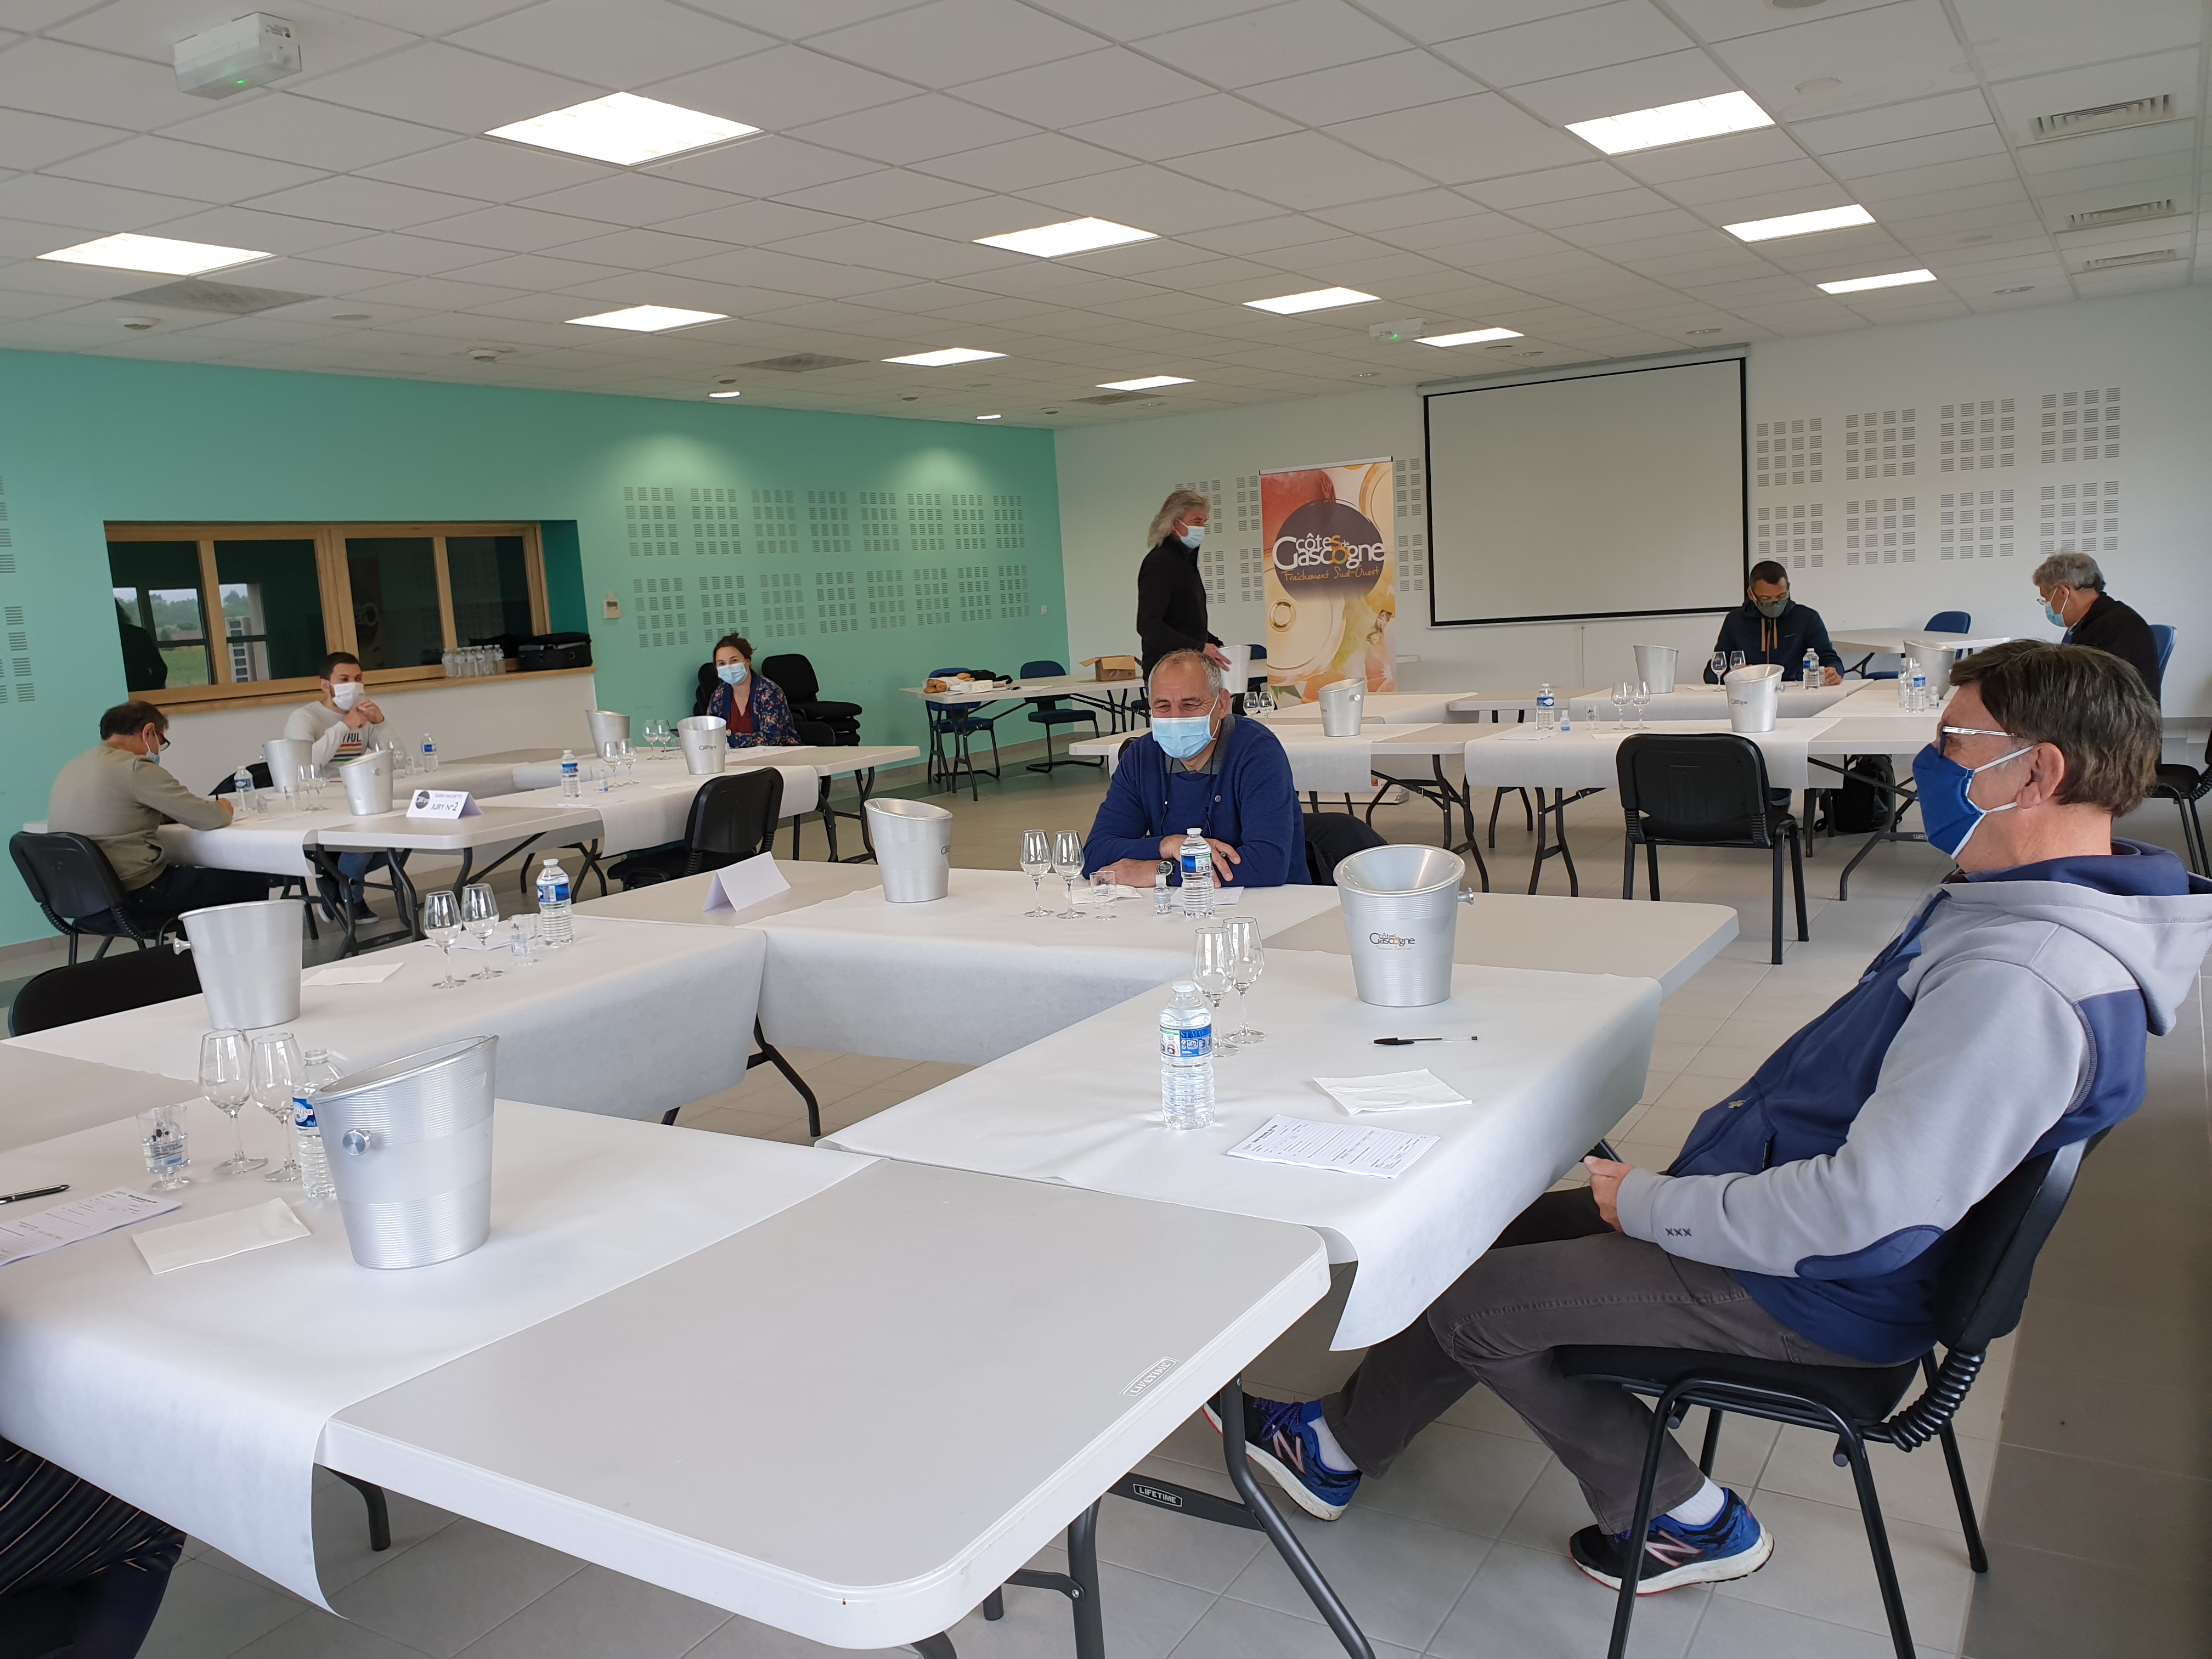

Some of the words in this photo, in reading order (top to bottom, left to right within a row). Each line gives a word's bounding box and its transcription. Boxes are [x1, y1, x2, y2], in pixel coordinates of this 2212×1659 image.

[1295, 532, 1341, 551] côtes
[1272, 536, 1385, 569] Gascogne
[1334, 565, 1380, 579] Sud-Ouest
[1369, 933, 1415, 947] Gascogne
[1129, 1361, 1171, 1393] LIFETIME
[1138, 1486, 1177, 1504] LIFETIME
